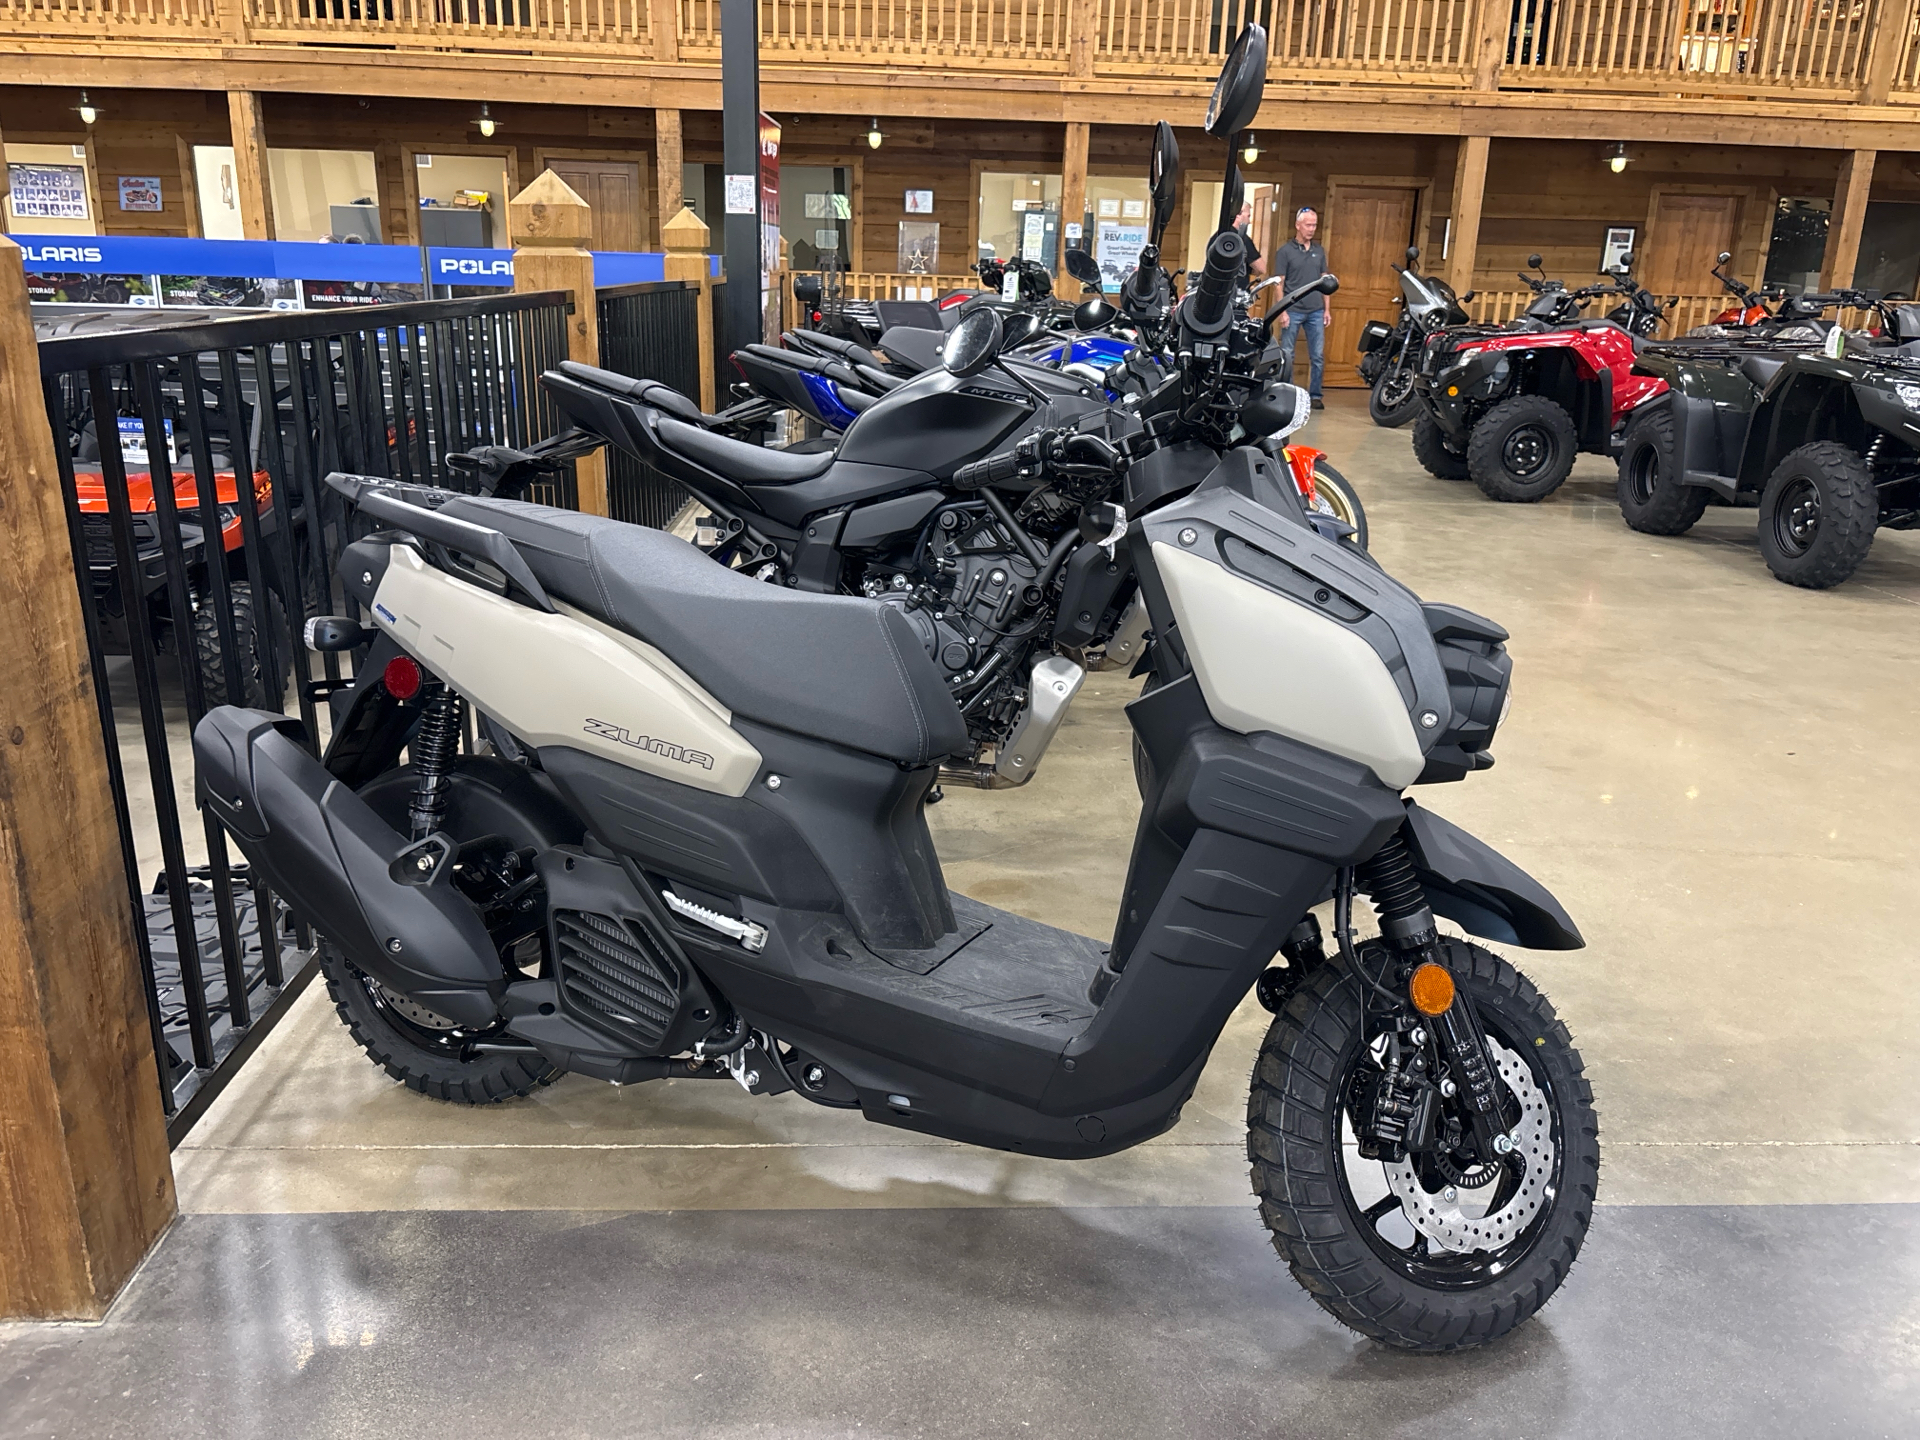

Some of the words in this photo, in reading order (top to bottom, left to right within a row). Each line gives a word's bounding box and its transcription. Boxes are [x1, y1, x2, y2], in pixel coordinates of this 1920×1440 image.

[440, 259, 514, 275] POLA
[170, 290, 198, 298] STORAGE
[311, 294, 341, 303] ENHANCE
[583, 718, 715, 770] ZUMA
